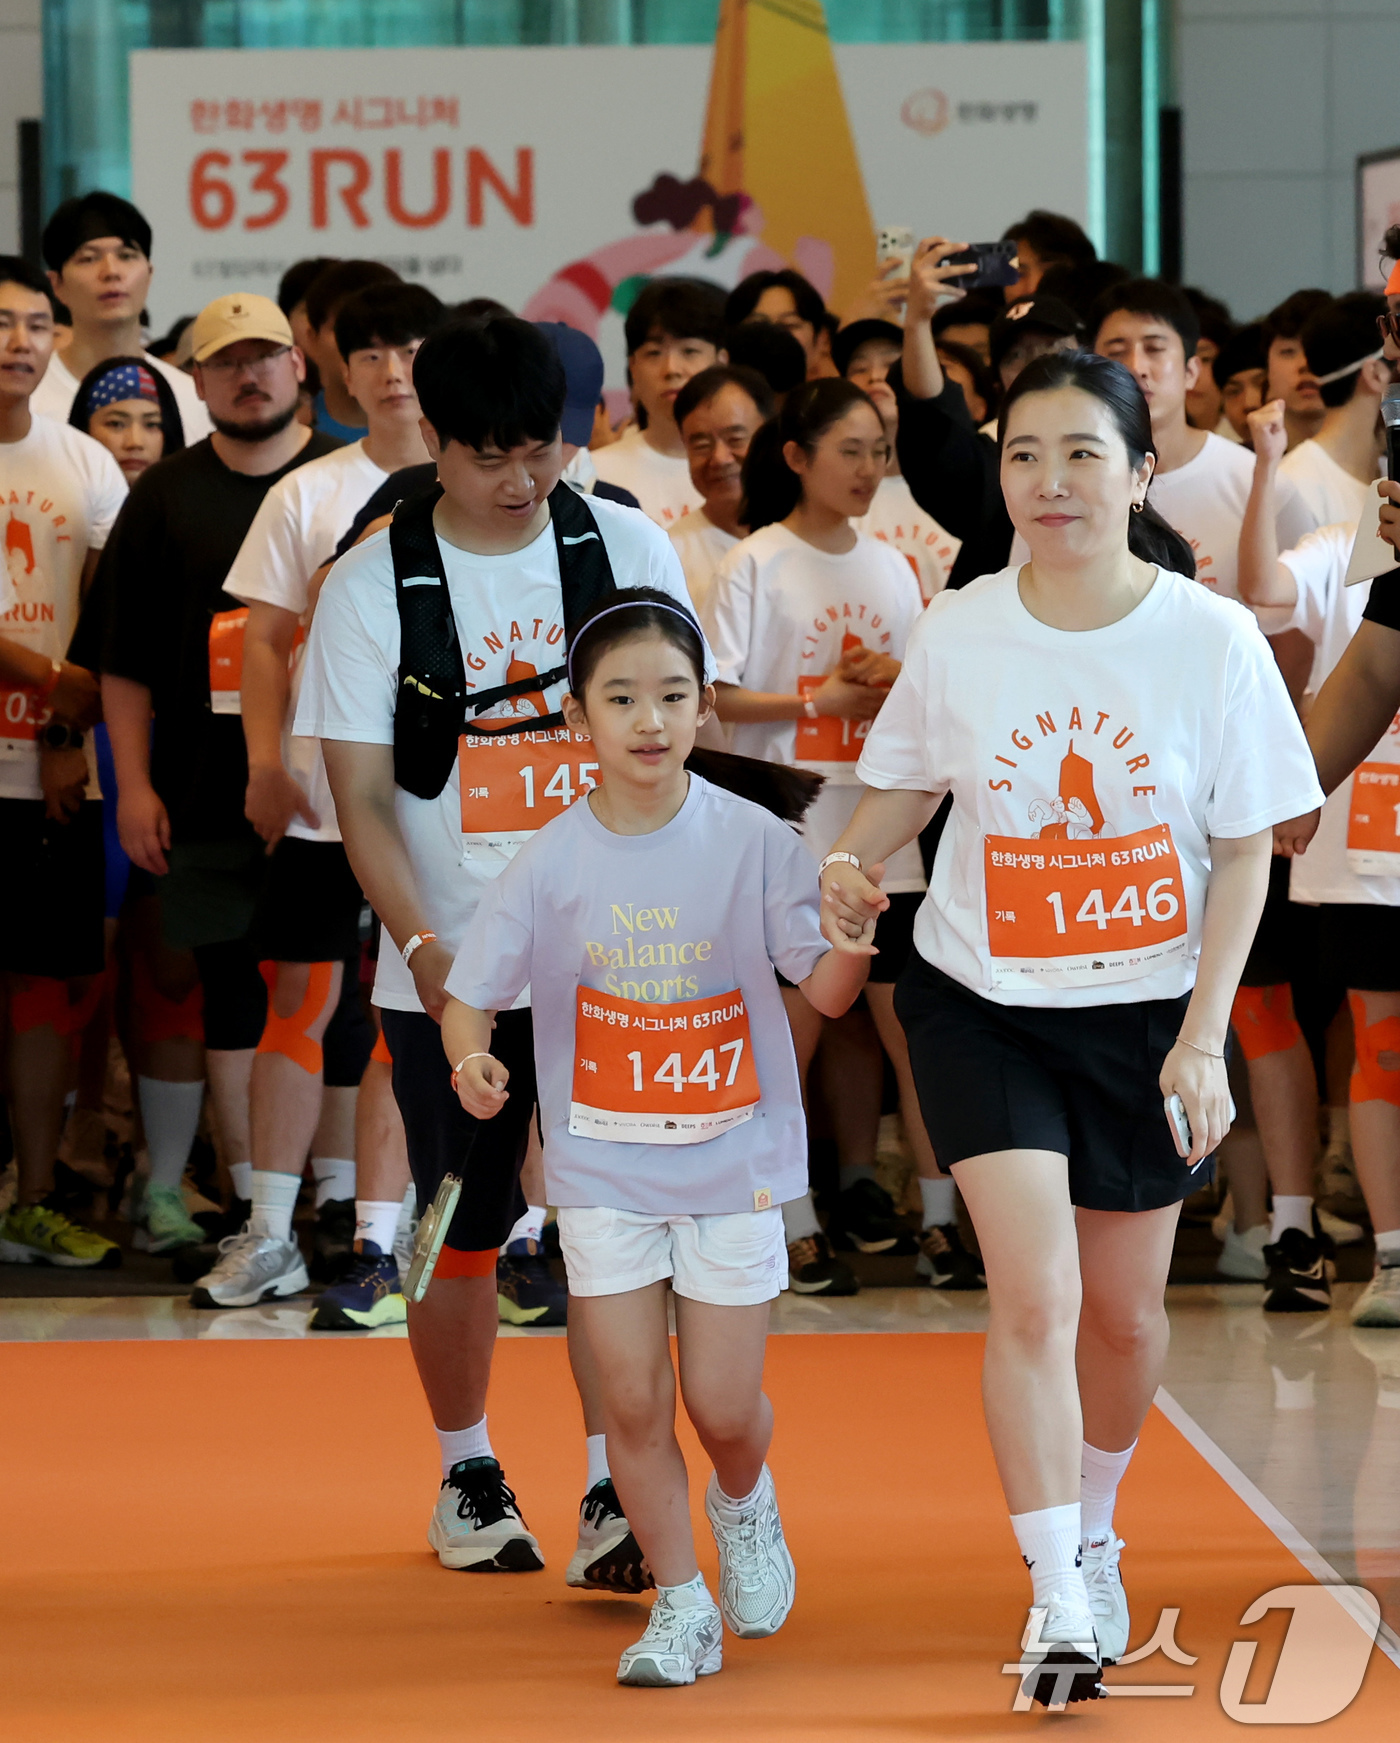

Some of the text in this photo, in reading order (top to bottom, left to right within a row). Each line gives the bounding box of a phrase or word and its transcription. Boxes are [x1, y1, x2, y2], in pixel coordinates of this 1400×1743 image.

[190, 96, 460, 135] 한화생명 시그니처
[523, 729, 571, 744] 시그니처
[988, 706, 1156, 797] SIGNATURE
[468, 787, 489, 798] 기록
[990, 851, 1046, 870] 한화생명
[1048, 853, 1106, 869] 시그니처
[610, 904, 680, 935] New
[994, 910, 1016, 923] 기록
[1045, 877, 1179, 934] 1446
[585, 937, 712, 970] Balance
[604, 973, 699, 1003] Sports
[581, 1001, 630, 1028] 한화생명
[632, 1017, 688, 1032] 시그니처
[580, 1058, 598, 1074] 기록
[626, 1037, 744, 1093] 1447
